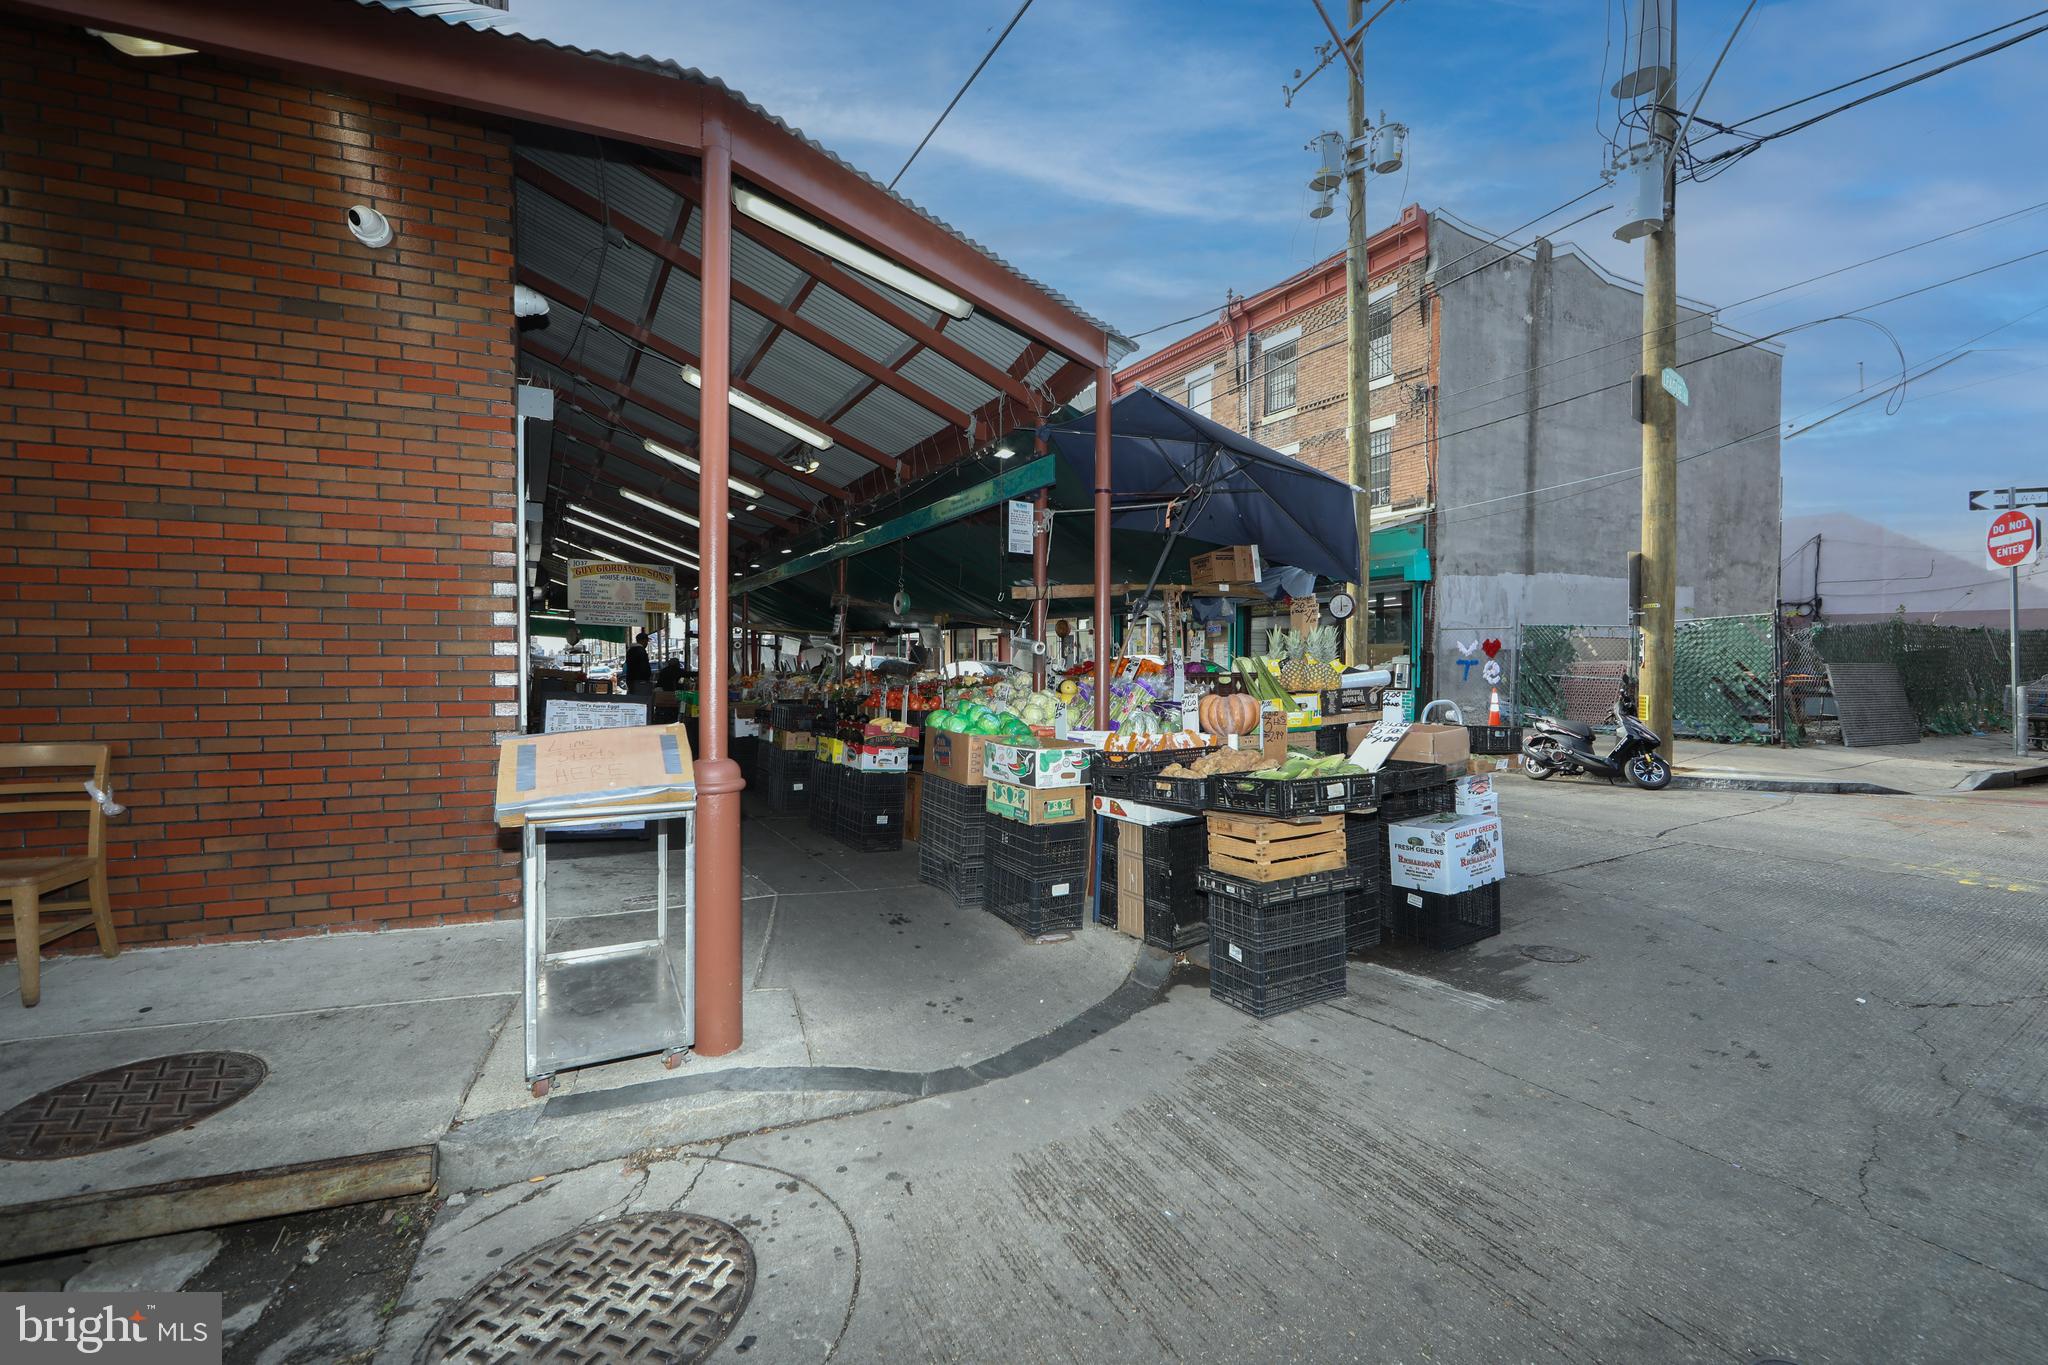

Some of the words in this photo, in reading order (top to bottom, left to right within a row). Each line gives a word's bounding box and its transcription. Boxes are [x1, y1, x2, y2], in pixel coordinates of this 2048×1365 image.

[1992, 524, 2005, 534] DO
[2009, 518, 2028, 531] NOT
[1996, 544, 2025, 557] ENTER
[575, 565, 593, 576] GUY
[596, 563, 640, 575] GIORDANO
[647, 568, 670, 582] SONS
[555, 762, 629, 784] HERE
[1455, 828, 1478, 840] QUALITY
[1479, 823, 1497, 833] GREENS
[1394, 843, 1415, 851] FRESH
[1415, 846, 1444, 855] GREENS
